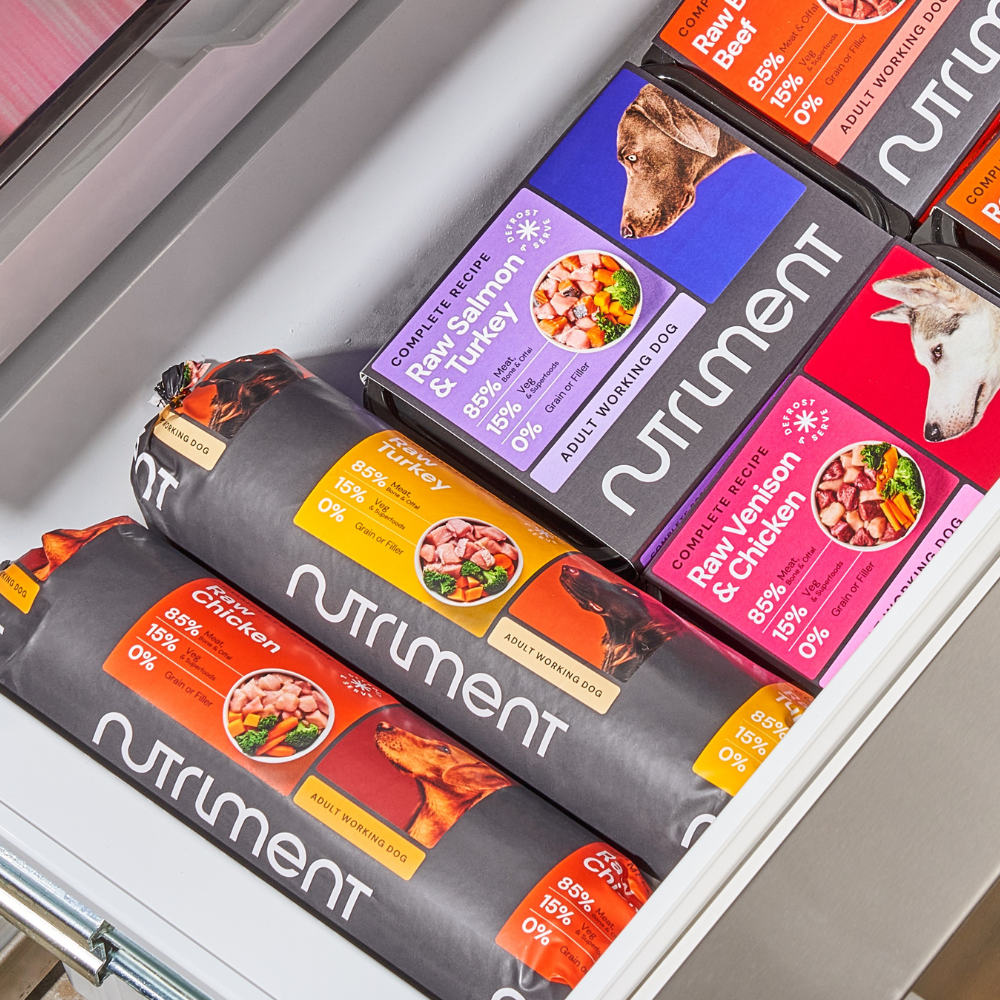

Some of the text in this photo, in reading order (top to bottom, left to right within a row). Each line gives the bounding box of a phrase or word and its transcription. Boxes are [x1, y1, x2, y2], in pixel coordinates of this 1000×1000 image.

[691, 5, 734, 55] Raw
[712, 18, 757, 70] Beef
[748, 3, 819, 92] 85% Meat & Offal
[807, 32, 839, 72] & Superfoods
[770, 49, 817, 109] 15% Veg
[793, 33, 868, 125] 0% Grain or Filler
[840, 91, 875, 135] ADULT
[872, 24, 926, 89] WORKING
[505, 209, 539, 243] DEFROST
[533, 218, 551, 249] SERVE
[391, 252, 491, 367] COMPLETE RECIPE
[405, 254, 525, 384] Raw Salmon
[429, 301, 519, 398] & Turkey
[501, 347, 534, 383] Bone & Offal
[463, 356, 517, 420] 85% Meat,
[486, 376, 536, 434] 15% Veg
[525, 360, 560, 400] & Superfoods
[560, 323, 679, 463] ADULT WORKING DOG
[511, 361, 590, 452] 0% Grain or Filler
[782, 398, 816, 436] DEFROST
[811, 408, 829, 442] SERVE
[190, 439, 209, 455] DOG
[376, 442, 452, 491] Turkey
[388, 436, 439, 468] Raw
[333, 476, 390, 513] 15% Veg
[350, 459, 412, 498] 85% Meat,
[317, 497, 404, 556] 0% Grain or Filler
[374, 507, 406, 531] Superfoods
[672, 496, 731, 570] COMPLETE
[728, 446, 769, 495] RECIPE
[687, 452, 802, 589] Raw Venison
[935, 518, 963, 548] DOG
[712, 491, 807, 604] & Chicken
[205, 584, 256, 617] Raw
[747, 556, 801, 625] 85% Meat,
[814, 560, 844, 598] Superfoods
[164, 606, 203, 638] 85%
[191, 589, 282, 655] Chicken
[772, 578, 821, 642] 15% Veg
[798, 560, 875, 659] 0% Grain or Filler
[145, 622, 202, 663] 15% Veg
[503, 632, 604, 699] ADULT WORKING DOG
[127, 643, 214, 708] 0% Grain or Filler
[734, 726, 769, 756] 15%
[750, 710, 790, 740] 85%
[718, 746, 749, 773] 0%
[310, 792, 408, 864] ADULT WORKING DOG
[539, 894, 597, 940] 15% Veg
[557, 876, 595, 913] 85%
[521, 917, 581, 968] 0% Grain
